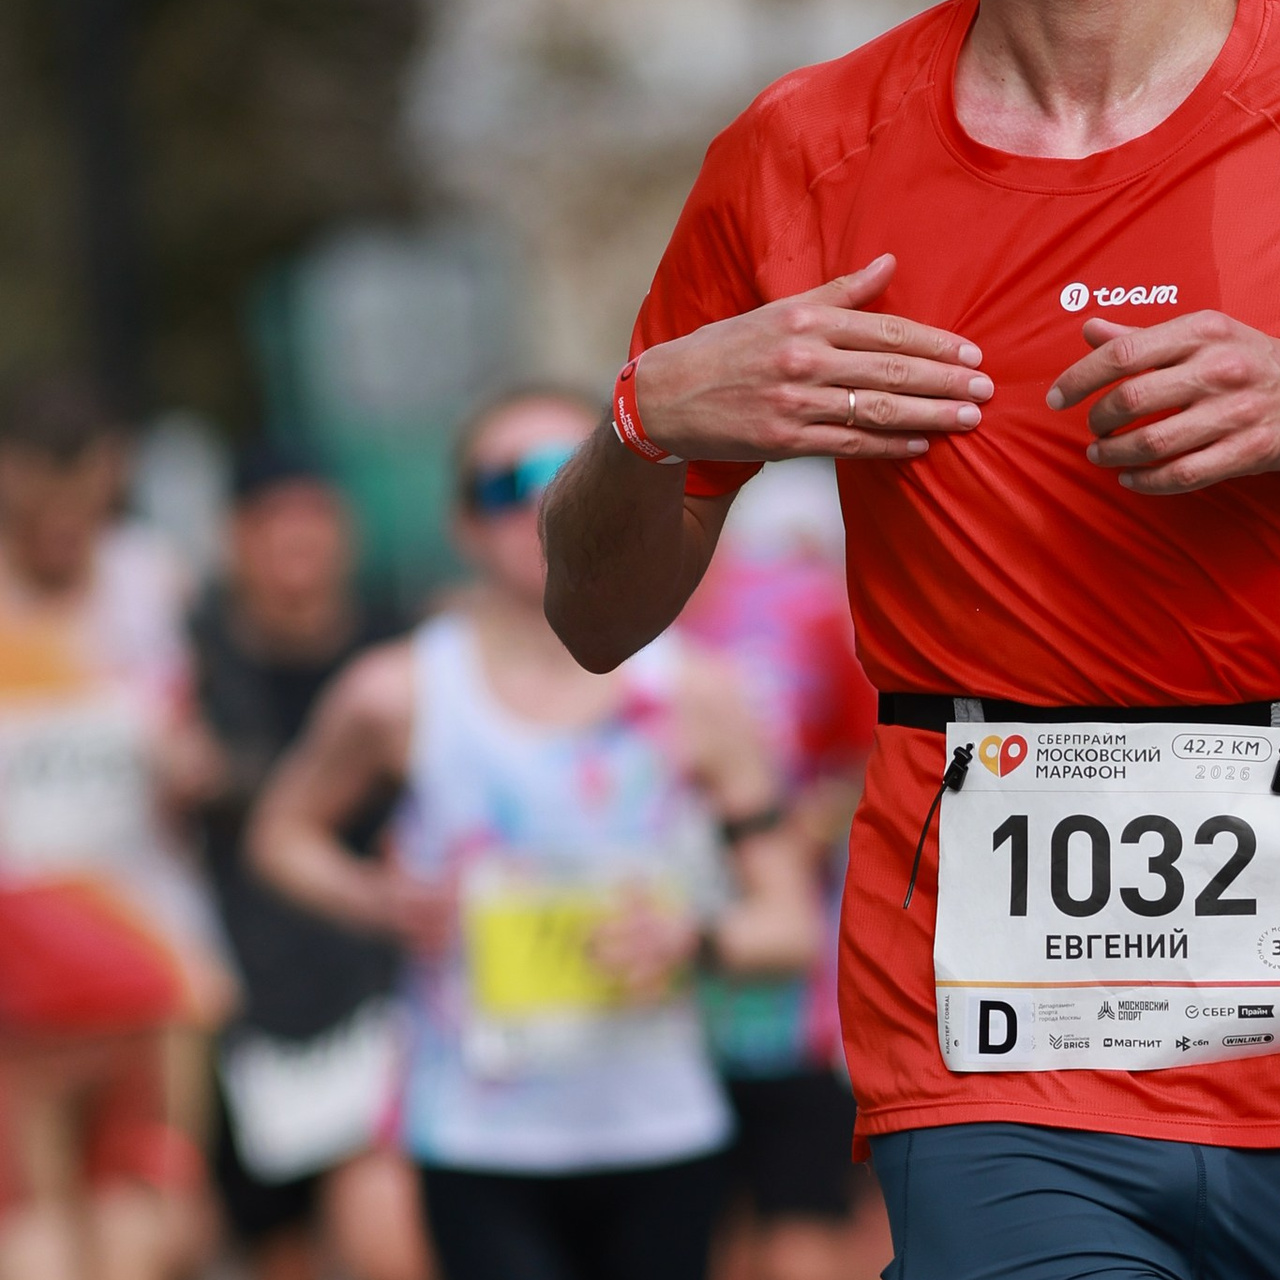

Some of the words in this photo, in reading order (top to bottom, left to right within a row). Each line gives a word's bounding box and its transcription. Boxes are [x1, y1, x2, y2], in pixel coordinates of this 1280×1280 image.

[1093, 285, 1178, 307] team
[1037, 733, 1127, 745] СБЕРПРАЙМ
[1183, 738, 1224, 756] 42,2
[1036, 746, 1161, 763] МОСКОВСКИЙ
[1035, 765, 1126, 779] МАРАФОН
[1194, 764, 1251, 781] 2026
[992, 814, 1257, 917] 1032
[1045, 928, 1188, 960] ЕВГЕНИЙ
[1118, 1000, 1169, 1011] МОСКОВСКИЙ
[1202, 1007, 1235, 1017] СБЕР
[1241, 1007, 1268, 1016] Прайм
[1118, 1011, 1142, 1021] СПОРТ
[979, 1000, 1018, 1054] D
[1063, 1041, 1090, 1049] BRICS
[1114, 1039, 1162, 1048] магнит
[1226, 1036, 1262, 1045] WINLINE
